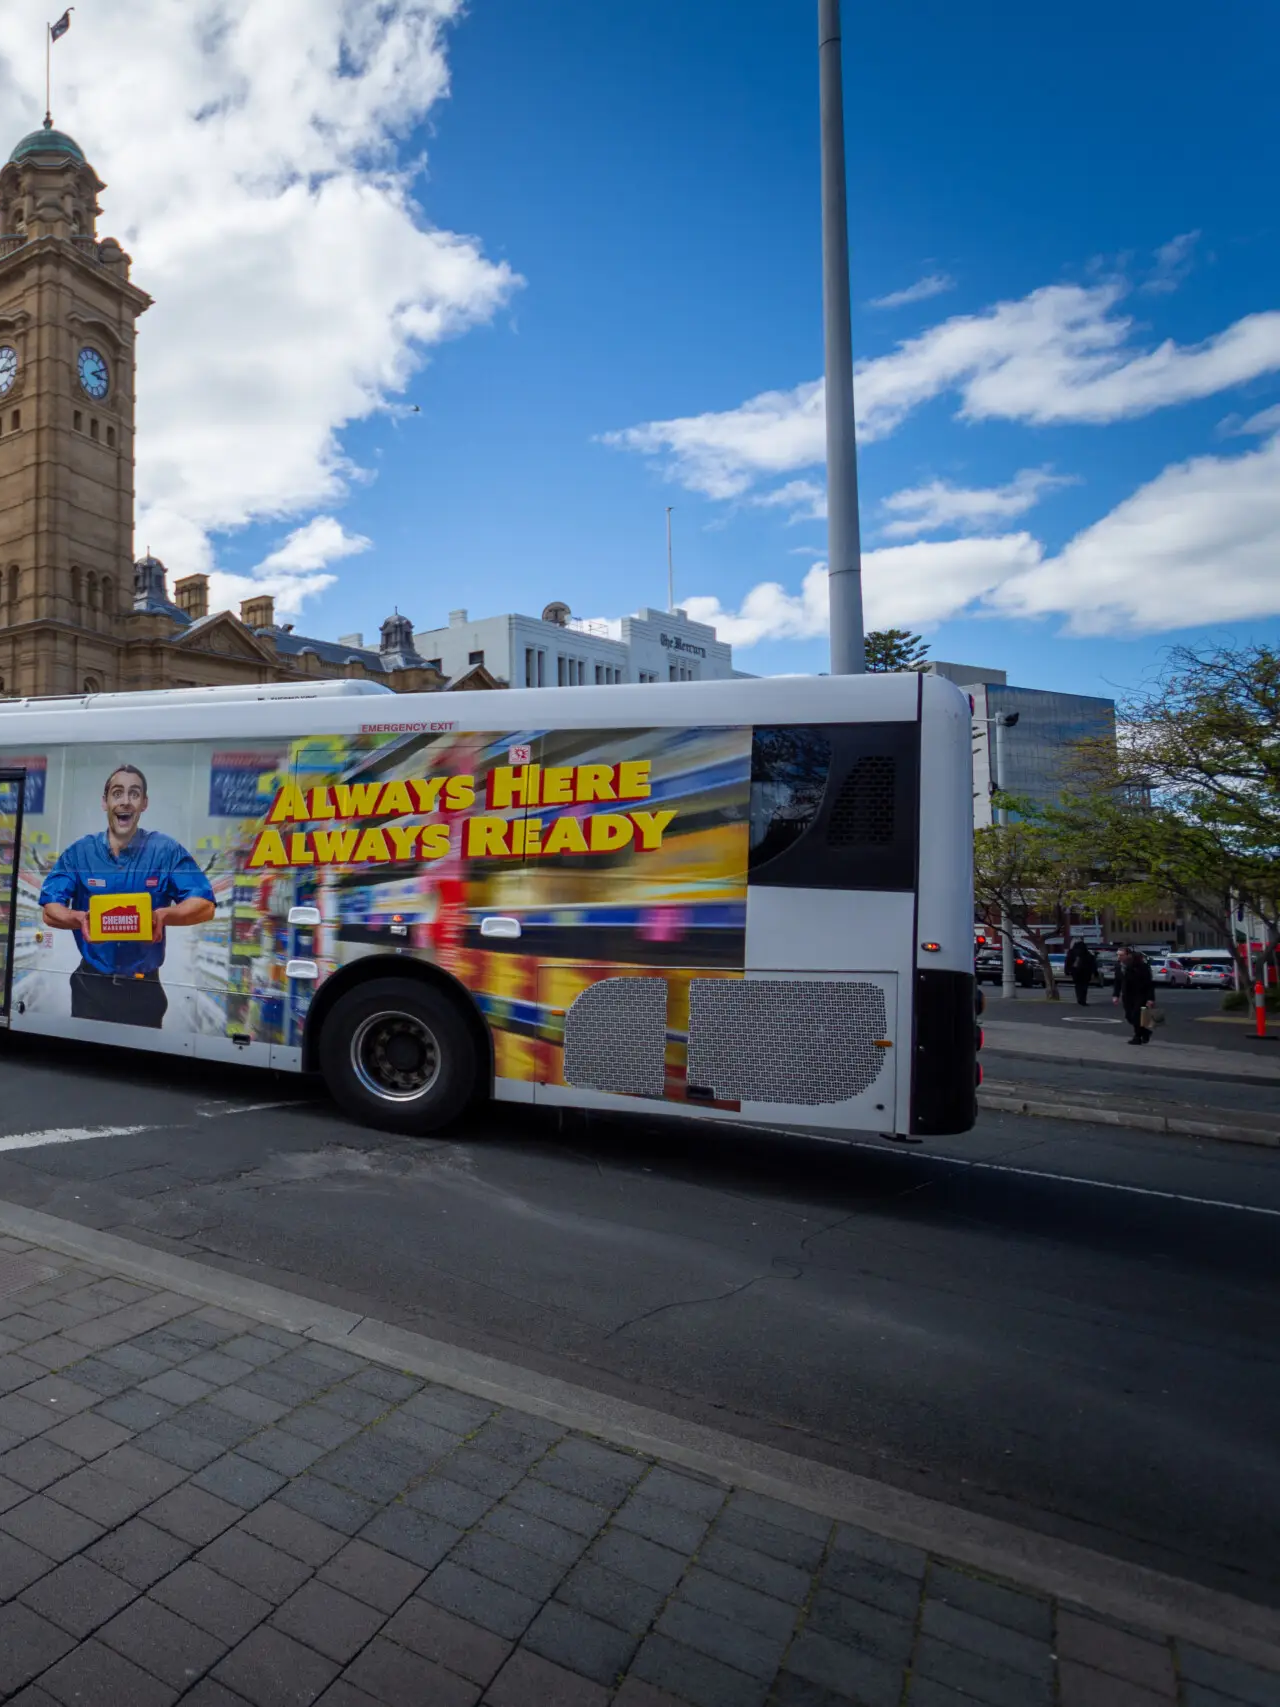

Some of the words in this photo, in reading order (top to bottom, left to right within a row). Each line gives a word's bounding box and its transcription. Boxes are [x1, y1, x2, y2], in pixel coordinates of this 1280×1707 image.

[674, 636, 706, 658] Mercury
[361, 723, 427, 732] EMERGENCY
[430, 722, 454, 731] EXIT
[265, 775, 476, 824] ALWAYS
[486, 760, 652, 809] HERE
[246, 823, 451, 869] ALWAYS
[461, 810, 678, 860] READY
[102, 915, 138, 925] CHEMIST
